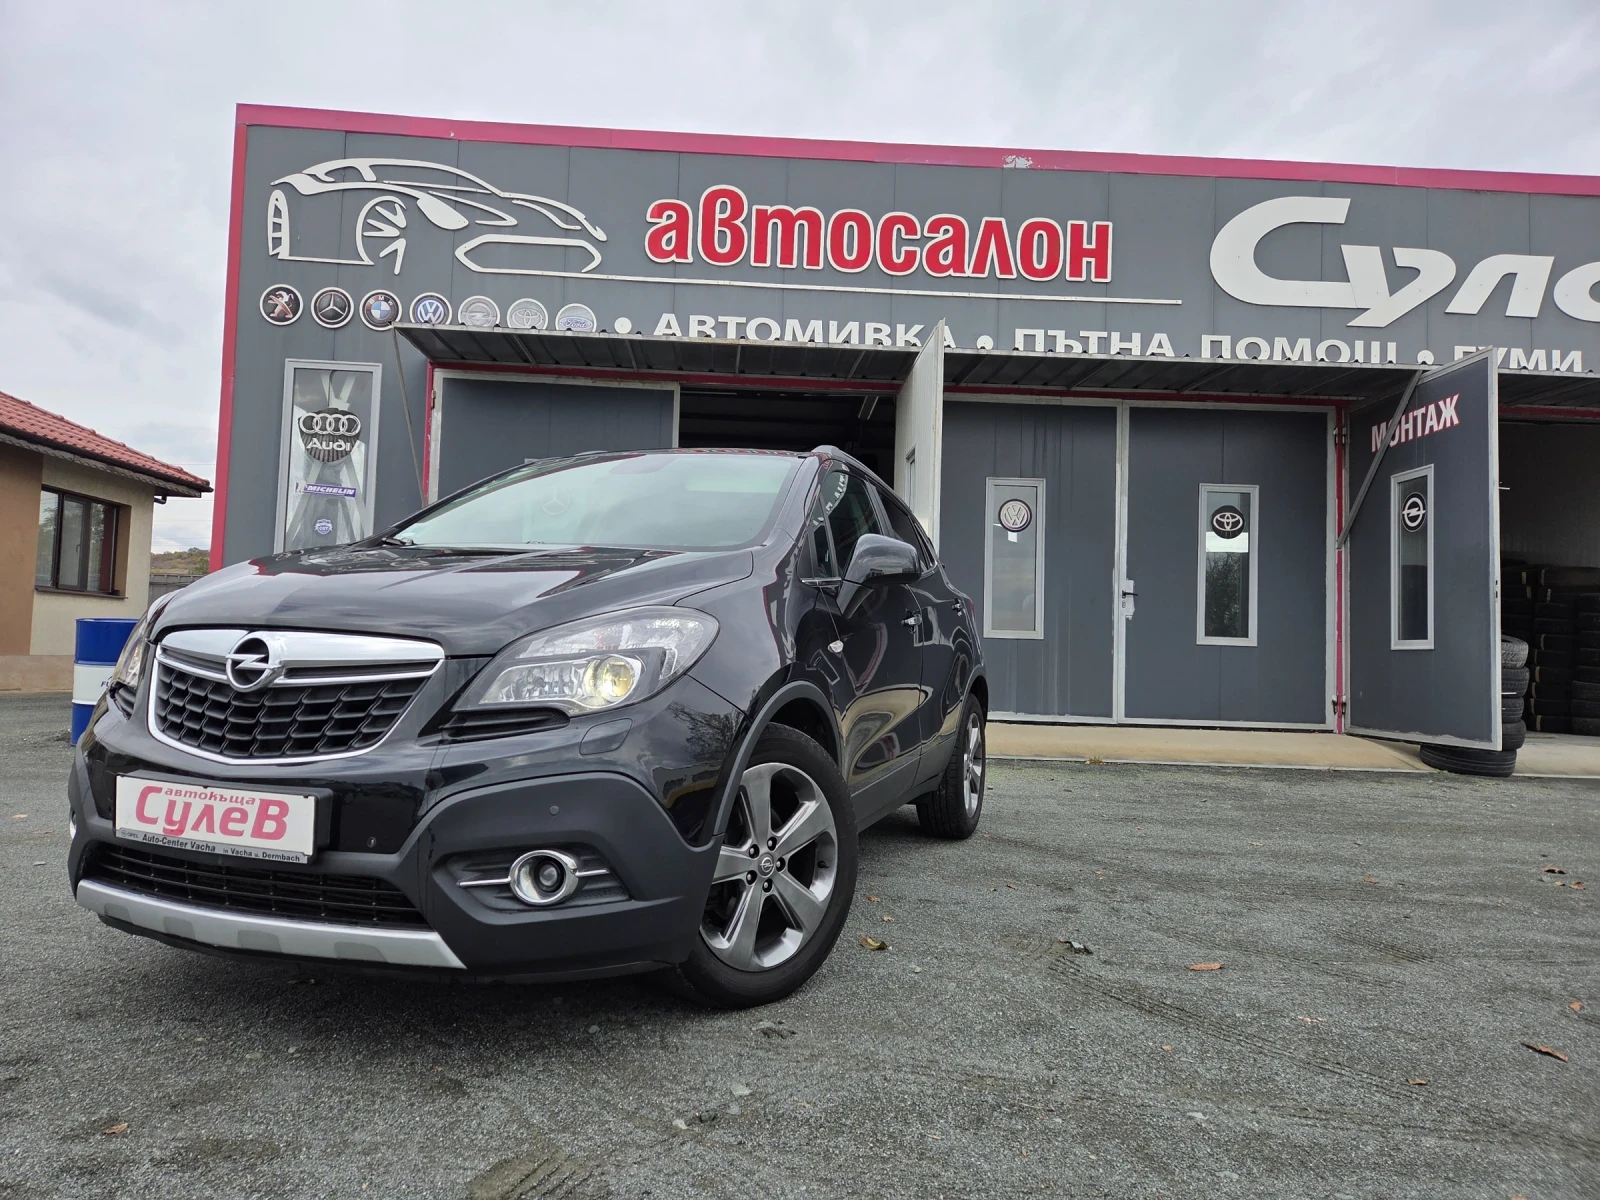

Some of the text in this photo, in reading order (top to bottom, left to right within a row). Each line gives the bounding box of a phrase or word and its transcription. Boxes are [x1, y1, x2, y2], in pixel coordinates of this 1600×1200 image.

[645, 185, 1112, 283] автосалон
[1015, 328, 1175, 357] ПЪТНА
[306, 485, 355, 496] MICHELIN
[142, 834, 188, 848] Auto-Center
[190, 844, 216, 853] Vacha
[230, 848, 252, 857] Vacha
[262, 852, 300, 862] Dermbach
